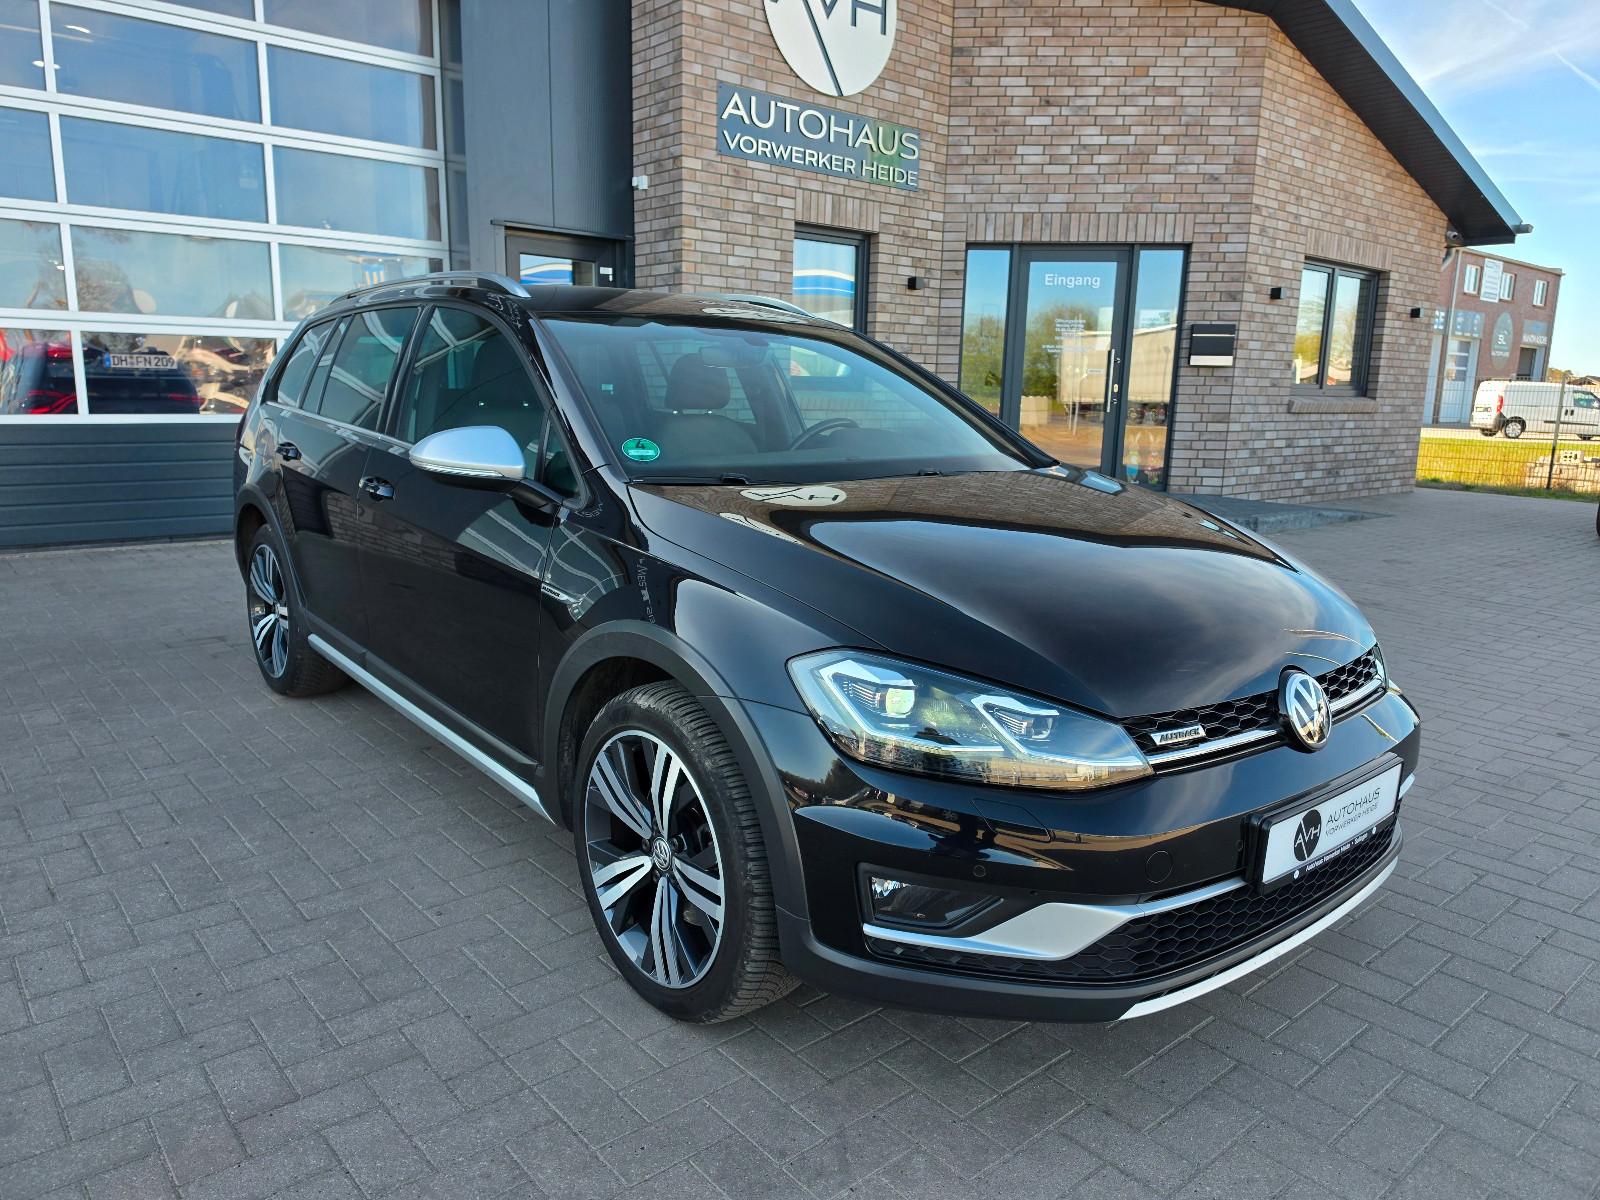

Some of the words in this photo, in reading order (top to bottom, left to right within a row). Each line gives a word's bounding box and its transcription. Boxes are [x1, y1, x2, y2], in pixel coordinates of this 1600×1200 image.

[721, 91, 919, 160] AUTOHAUS
[723, 130, 855, 174] VORWERKER
[861, 159, 918, 186] HEIDE
[1044, 273, 1101, 289] Eingang
[111, 355, 128, 366] DH
[154, 356, 176, 367] 209
[1159, 727, 1201, 742] ALLTRACK
[1326, 787, 1381, 826] AUTOHAUS
[1294, 819, 1321, 861] AVH
